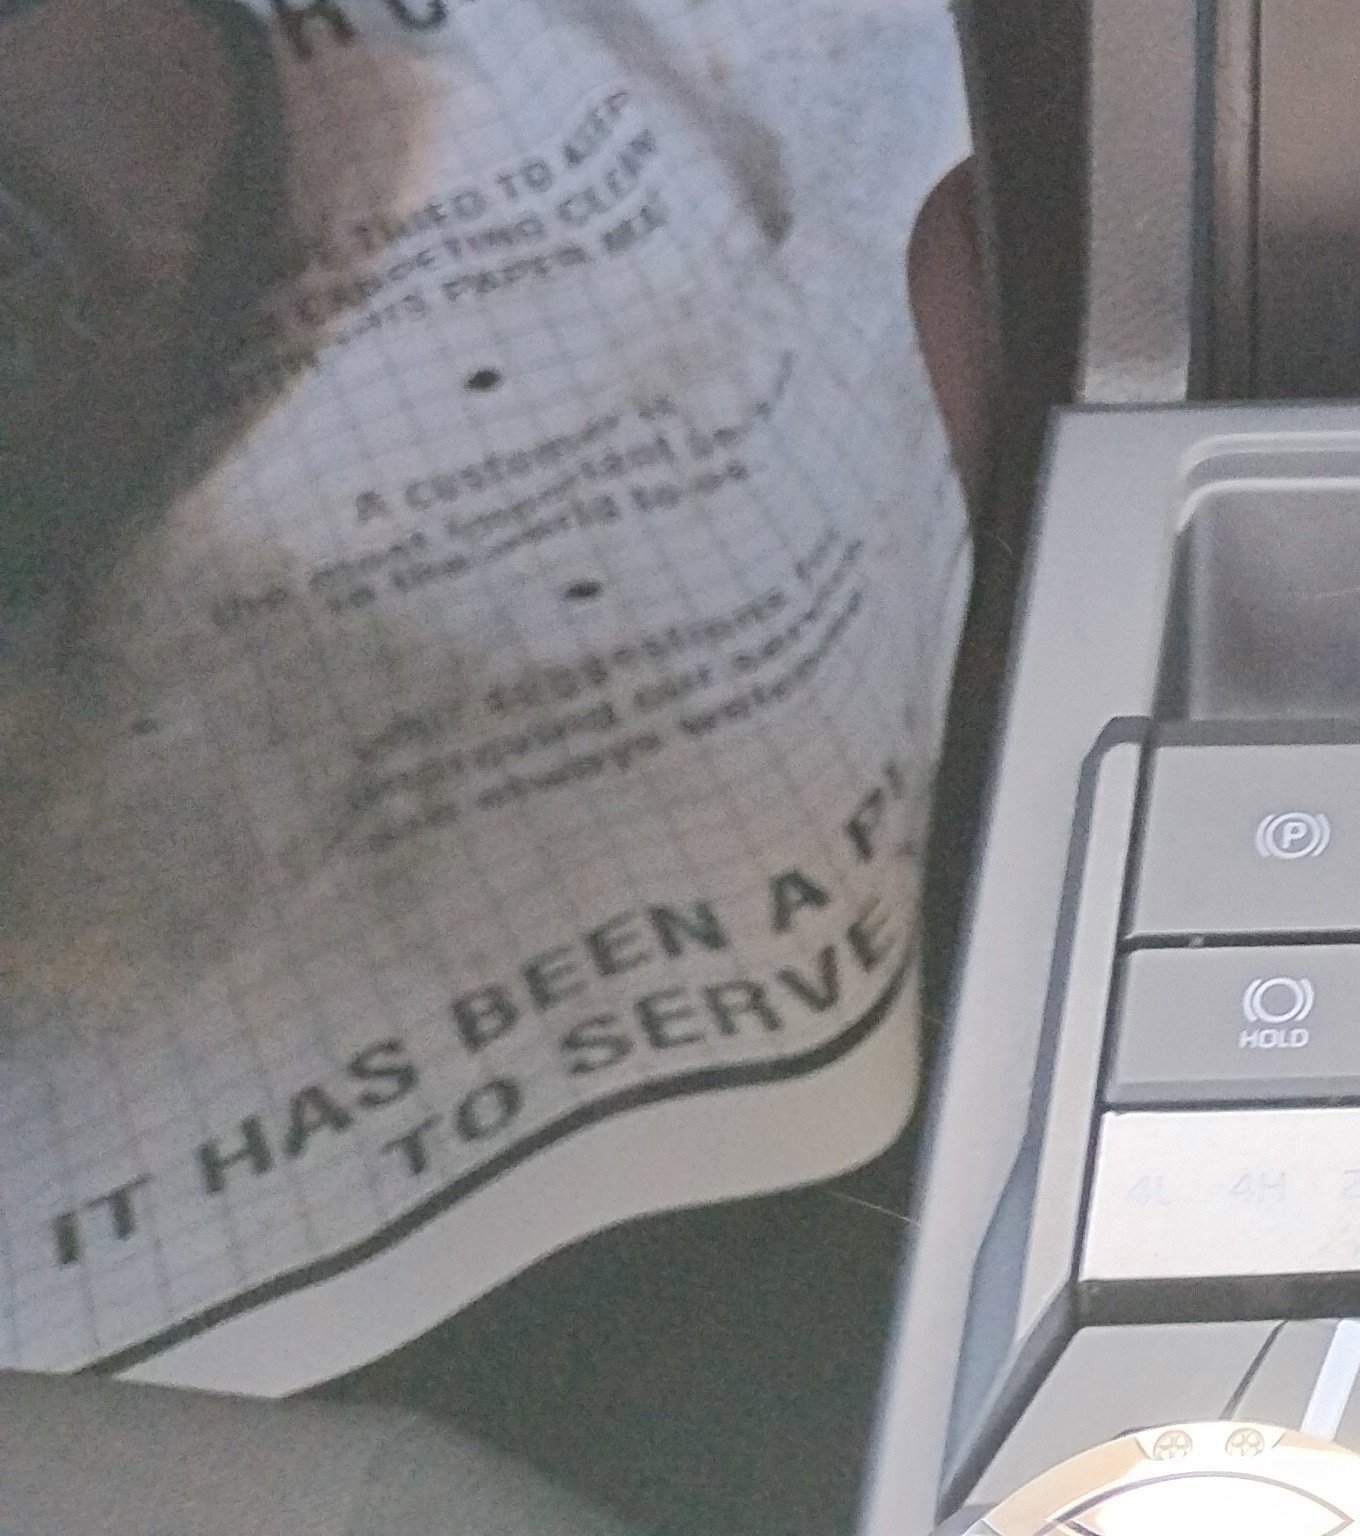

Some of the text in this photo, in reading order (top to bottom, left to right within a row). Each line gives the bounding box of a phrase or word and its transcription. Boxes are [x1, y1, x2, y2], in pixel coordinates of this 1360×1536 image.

[498, 157, 553, 200] TO
[354, 489, 388, 524] A
[386, 894, 893, 1176] TO SERVE
[1237, 1027, 1311, 1050] HOLD
[48, 1173, 152, 1266] IT
[196, 1037, 419, 1196] HAS
[450, 900, 726, 1053] BEEN
[771, 866, 831, 934] A
[1227, 1170, 1287, 1204] 4H
